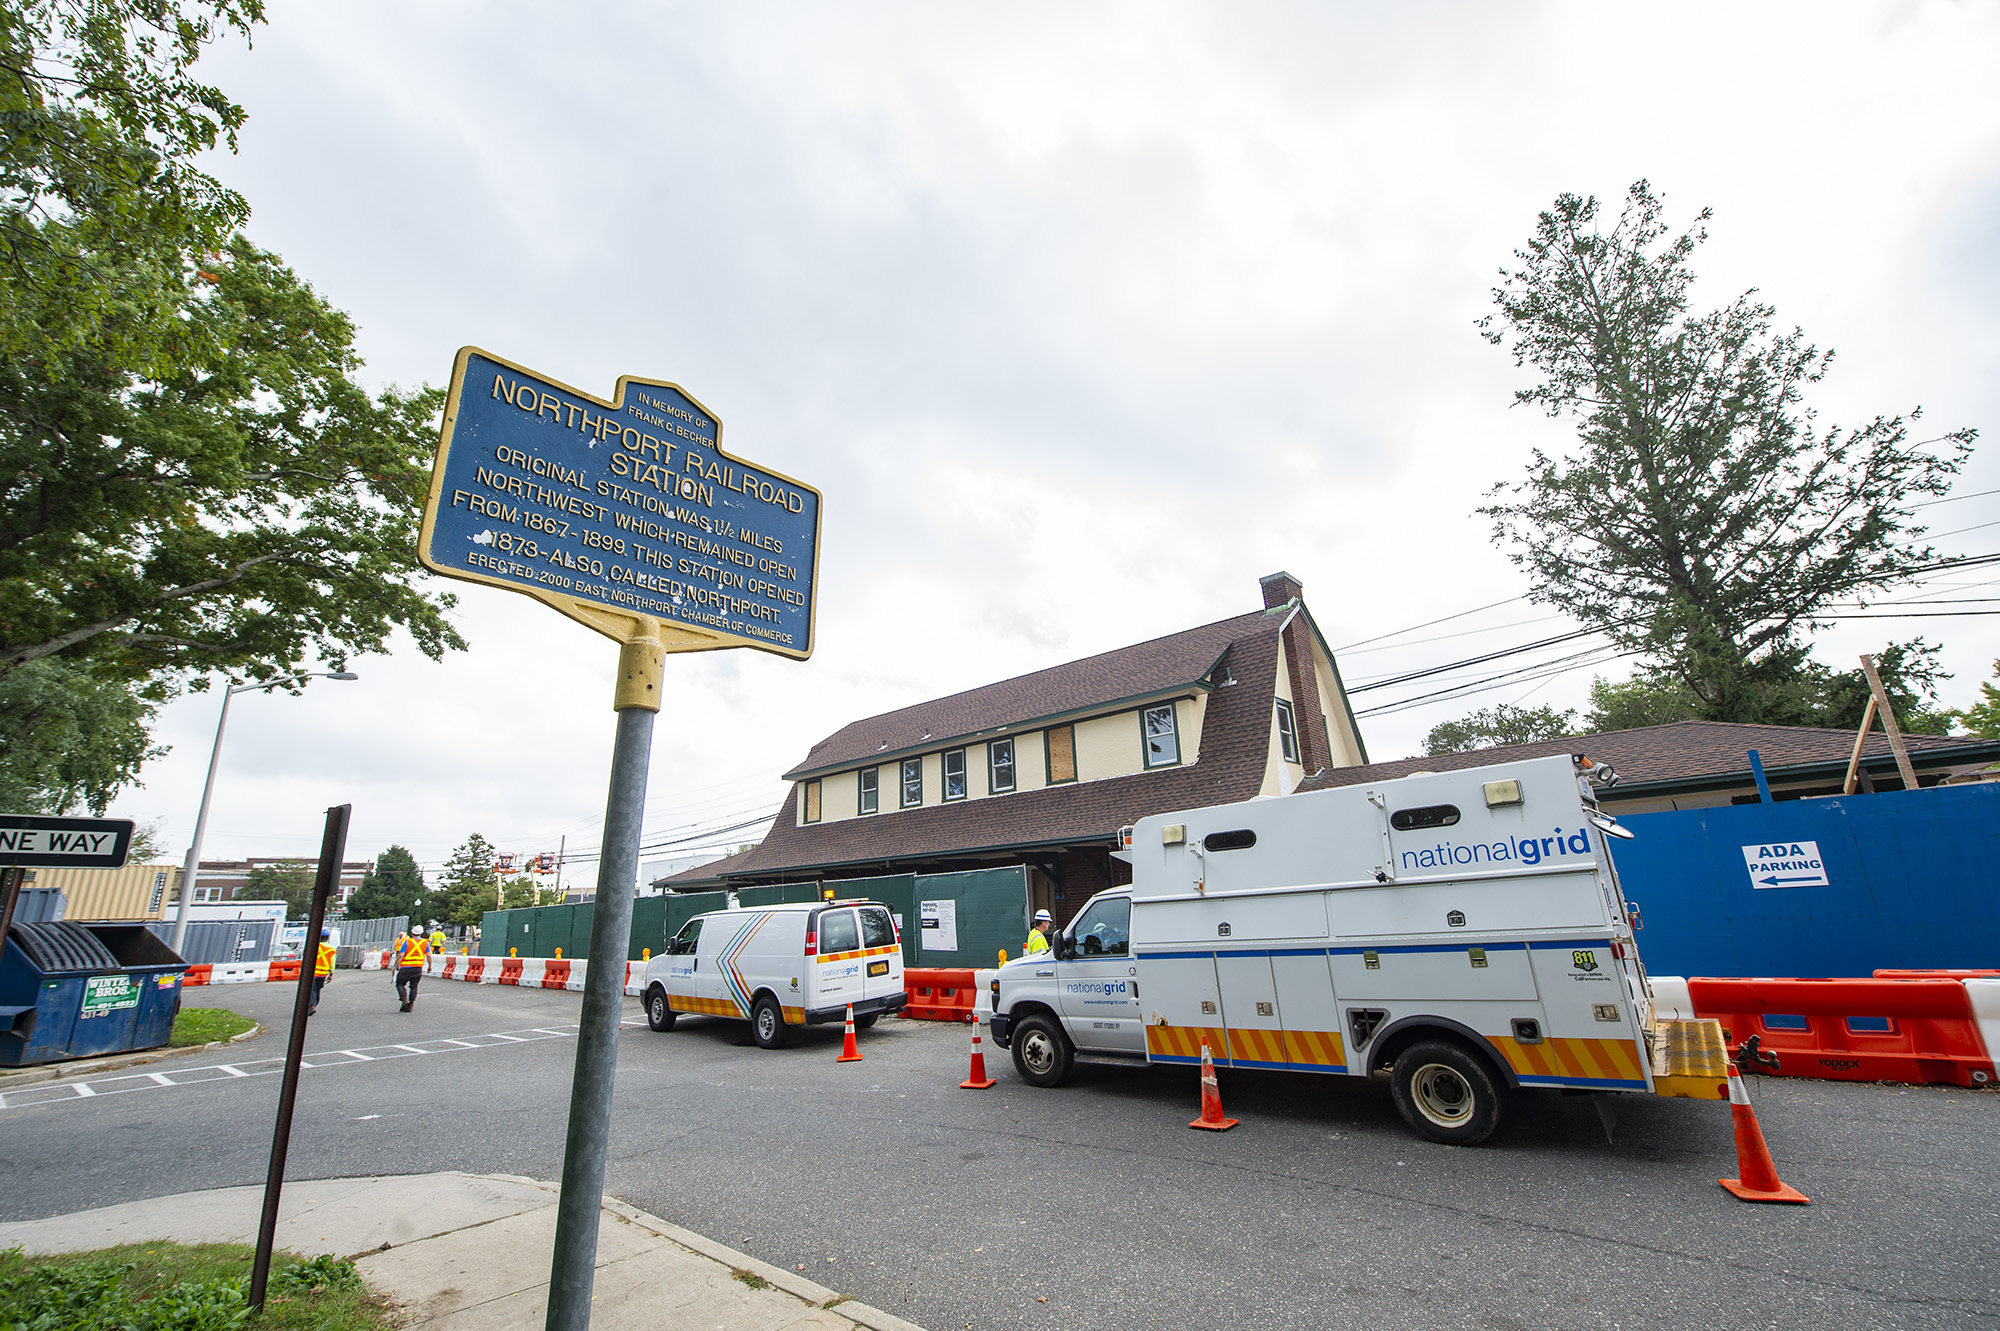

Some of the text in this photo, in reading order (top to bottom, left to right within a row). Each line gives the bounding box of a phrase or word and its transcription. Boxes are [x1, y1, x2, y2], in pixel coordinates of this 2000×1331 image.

[628, 405, 715, 449] FRANK C. BECHER
[638, 392, 708, 429] IN MEMORY OF
[492, 374, 803, 514] NORTHPORT RAILROAD
[610, 452, 713, 508] STATION
[496, 445, 590, 491] ORIGINAL
[597, 480, 669, 518] STATION
[675, 505, 709, 531] WAS
[739, 528, 782, 553] MILES
[476, 466, 796, 581] NORTHWEST WHICH REMAINED OPEN
[452, 489, 517, 523] FROM
[632, 542, 673, 569] THIS
[677, 558, 743, 590] STATION
[748, 579, 804, 606] OPENED
[467, 551, 792, 644] ERECTED 2000 EAST NORTHPORT CHAMBER OF COMMERCE
[610, 565, 681, 598] CALLED
[50, 832, 109, 852] WAY
[1402, 827, 1592, 869] nationalgrid
[1749, 844, 1822, 873] ADA PARKING
[822, 964, 859, 977] nationalgrid
[1573, 951, 1595, 964] 811
[95, 986, 131, 998] BROS.
[1067, 980, 1126, 995] nationalgrid
[1818, 1058, 1861, 1069] YODOCK
